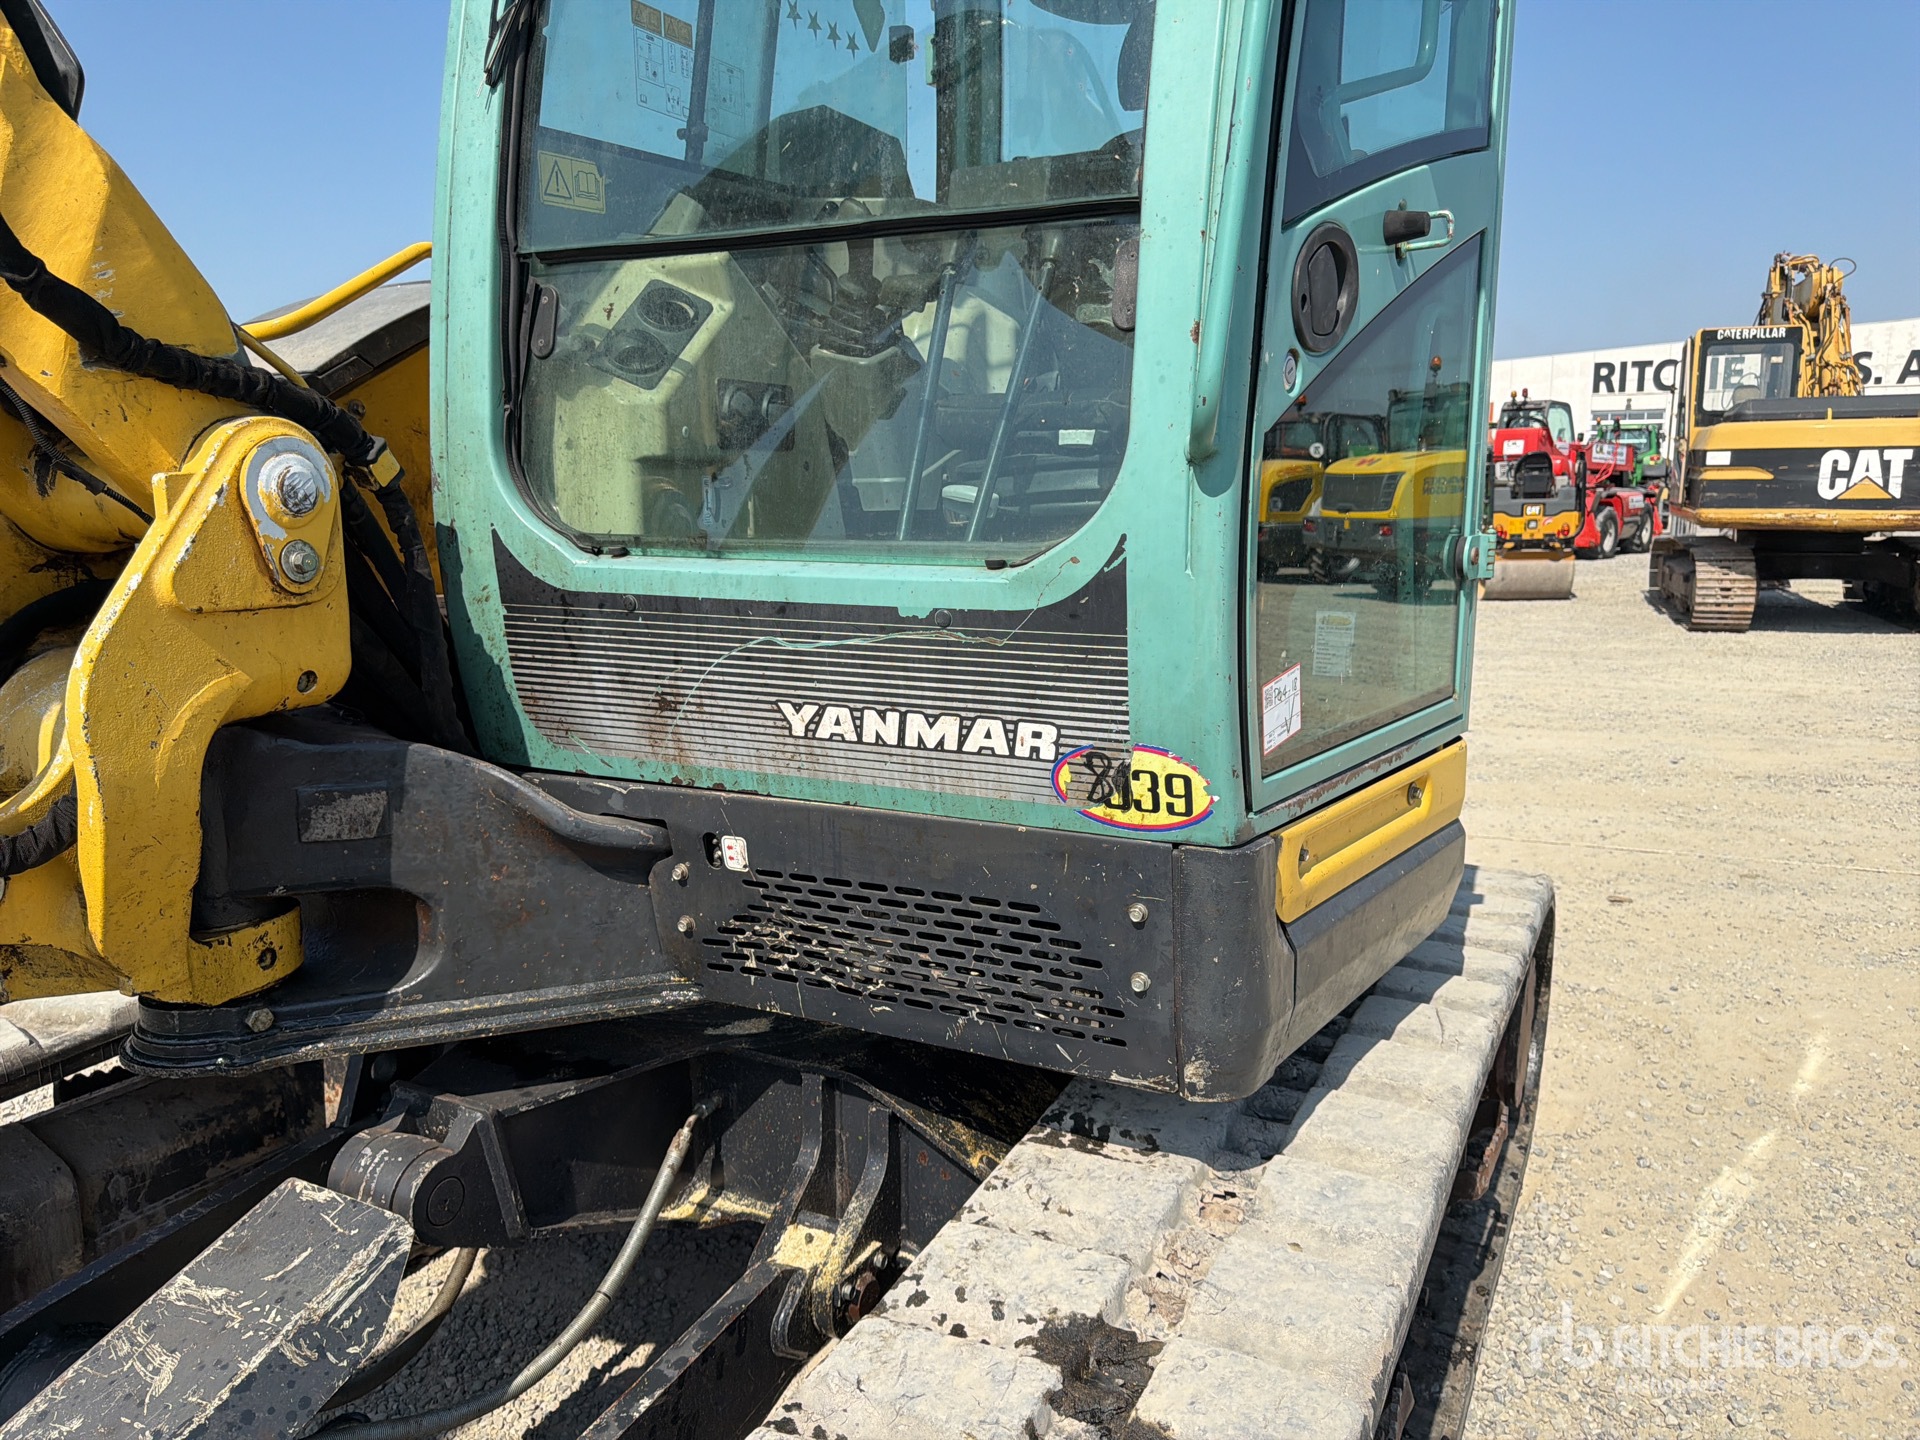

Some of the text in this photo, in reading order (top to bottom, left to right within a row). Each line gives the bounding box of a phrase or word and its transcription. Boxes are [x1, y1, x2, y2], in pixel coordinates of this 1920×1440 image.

[1717, 327, 1787, 340] CATERPILLAR
[1817, 449, 1914, 501] CAT
[776, 701, 1059, 761] YANMAR
